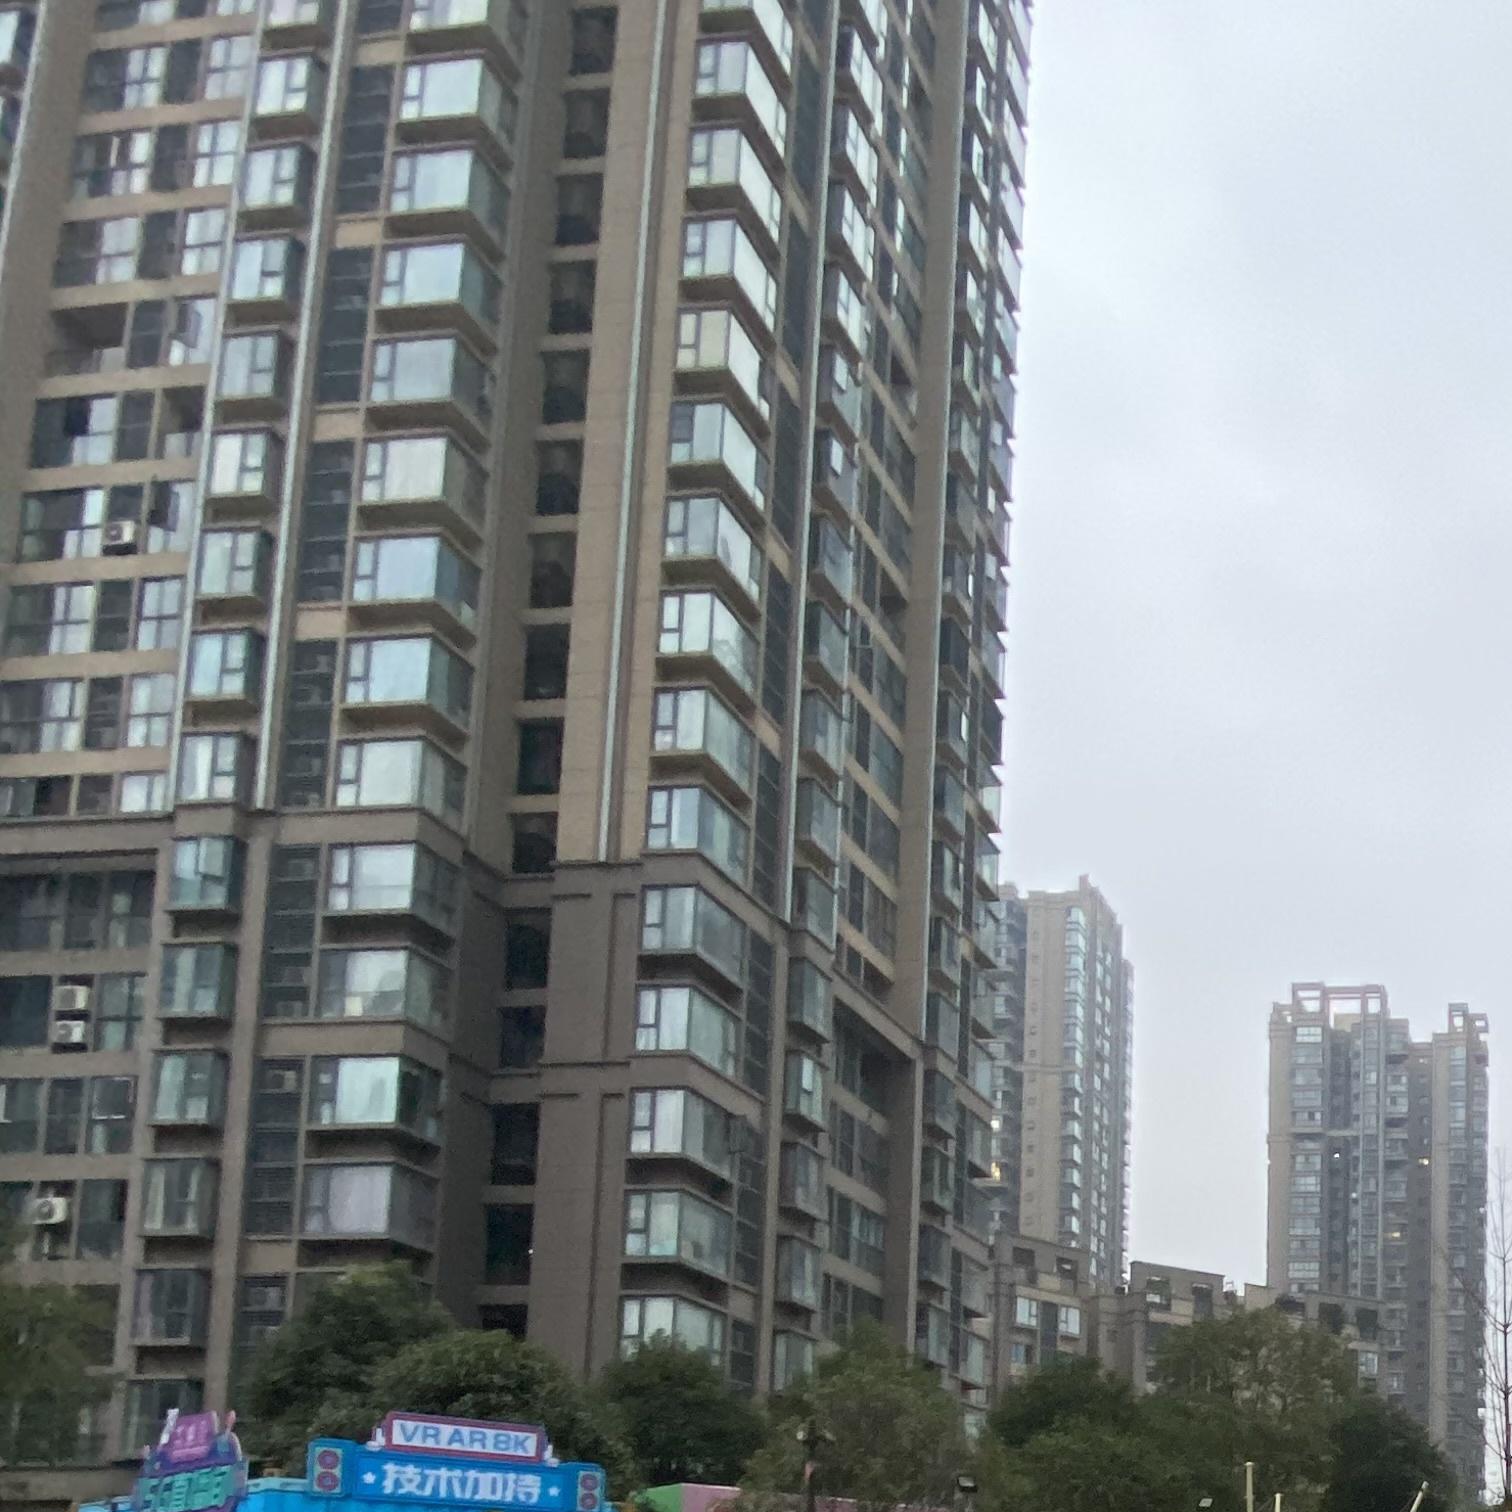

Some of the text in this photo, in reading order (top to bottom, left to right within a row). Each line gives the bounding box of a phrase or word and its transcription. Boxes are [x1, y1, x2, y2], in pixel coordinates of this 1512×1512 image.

[400, 1423, 530, 1454] VR AR 8K
[382, 1463, 542, 1504] 技术加持
